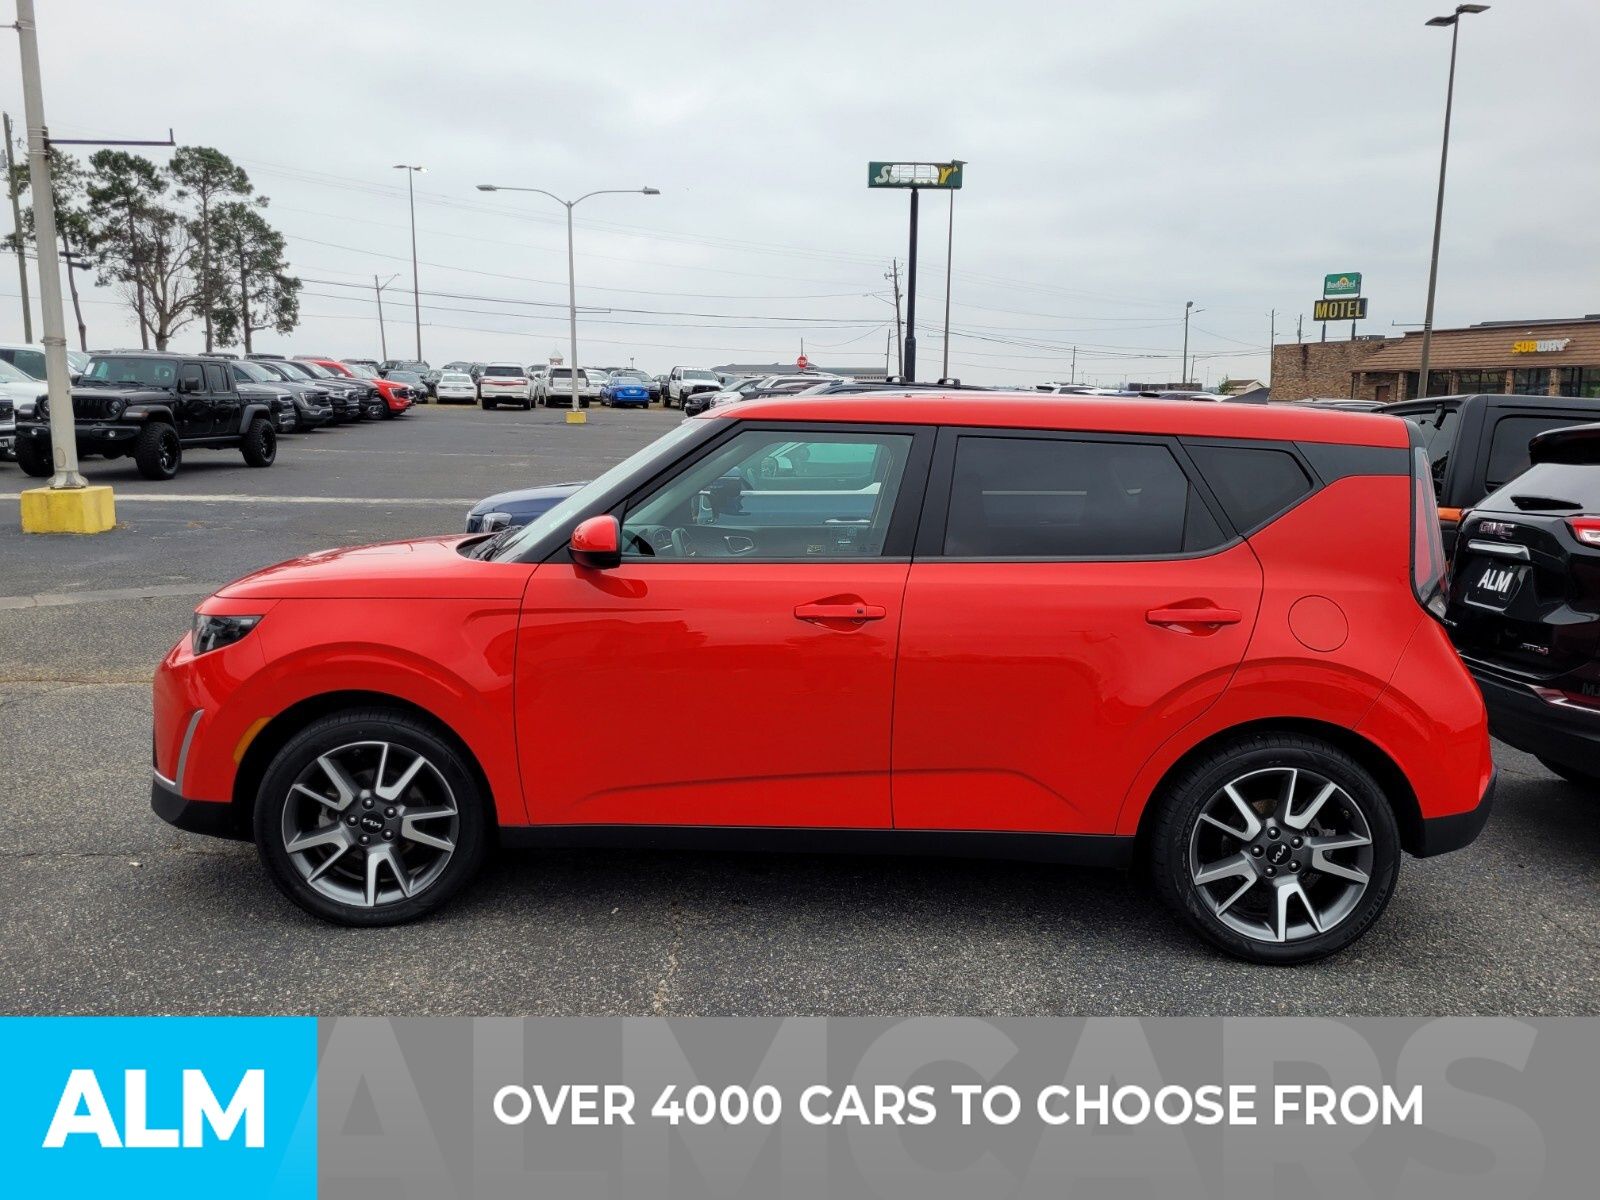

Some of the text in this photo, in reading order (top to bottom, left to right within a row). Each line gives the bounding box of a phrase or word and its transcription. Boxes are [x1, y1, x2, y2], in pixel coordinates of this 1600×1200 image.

[1315, 300, 1363, 319] MOTEL
[1512, 338, 1570, 353] SUBWAY
[1480, 521, 1515, 537] GMC
[1477, 569, 1513, 593] ALM
